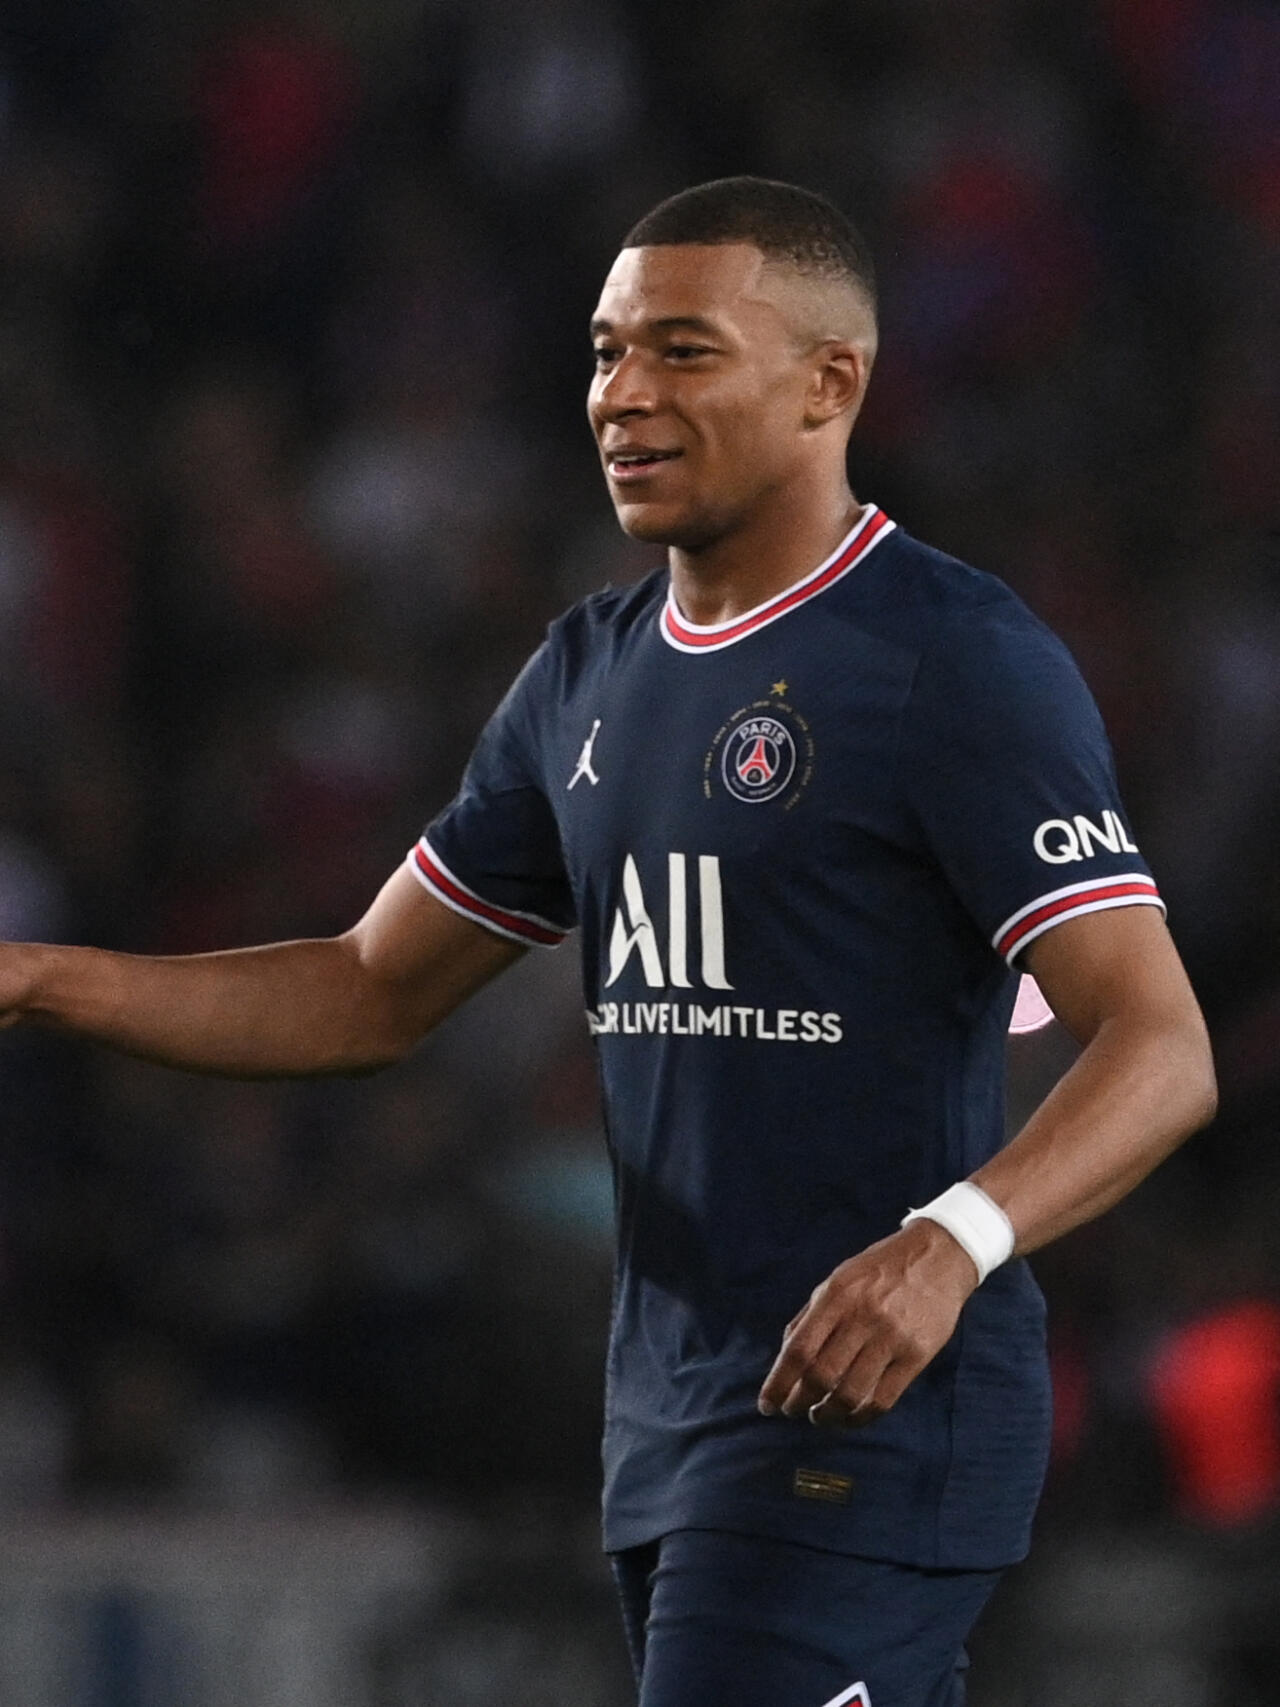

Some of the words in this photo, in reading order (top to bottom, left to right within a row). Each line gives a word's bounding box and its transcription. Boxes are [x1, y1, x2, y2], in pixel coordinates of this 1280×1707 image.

[738, 721, 787, 746] PARIS
[622, 1002, 670, 1035] LIVE
[671, 1002, 844, 1044] LIMITLESS
